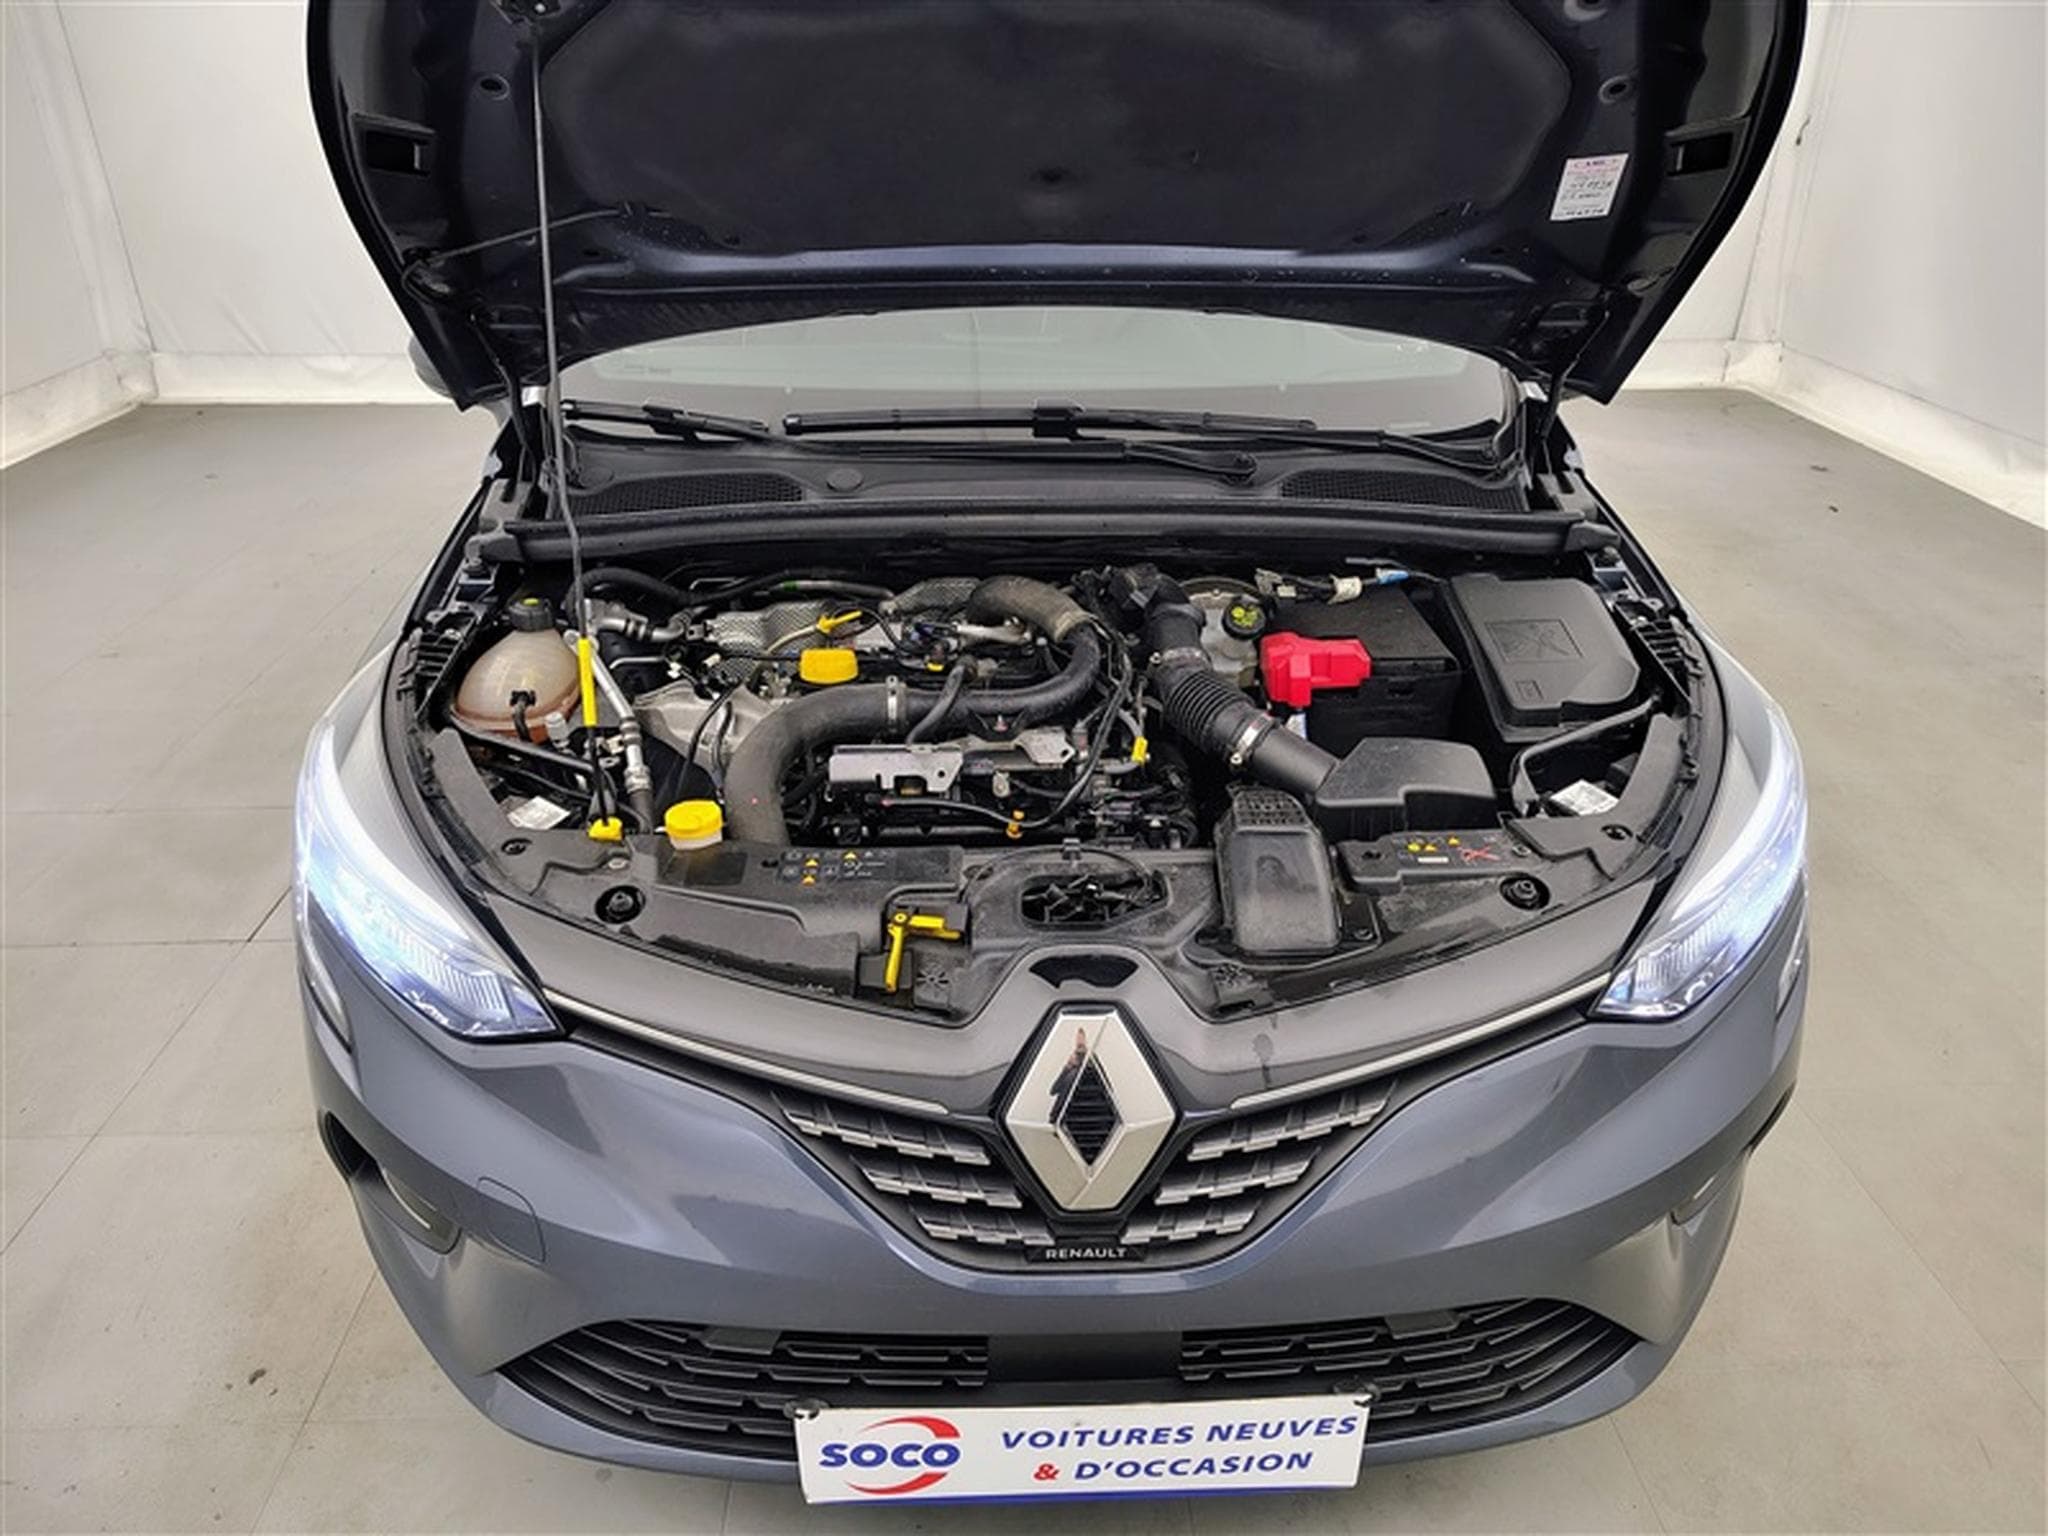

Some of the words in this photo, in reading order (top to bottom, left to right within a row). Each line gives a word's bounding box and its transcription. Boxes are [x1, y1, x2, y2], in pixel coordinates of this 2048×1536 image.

[1045, 1247, 1127, 1259] RENAULT
[1002, 1425, 1193, 1450] VOITURES
[1206, 1416, 1358, 1443] NEUVES
[819, 1442, 961, 1469] SOCO
[1033, 1463, 1060, 1481] &
[1073, 1452, 1313, 1481] D'OCCASION
